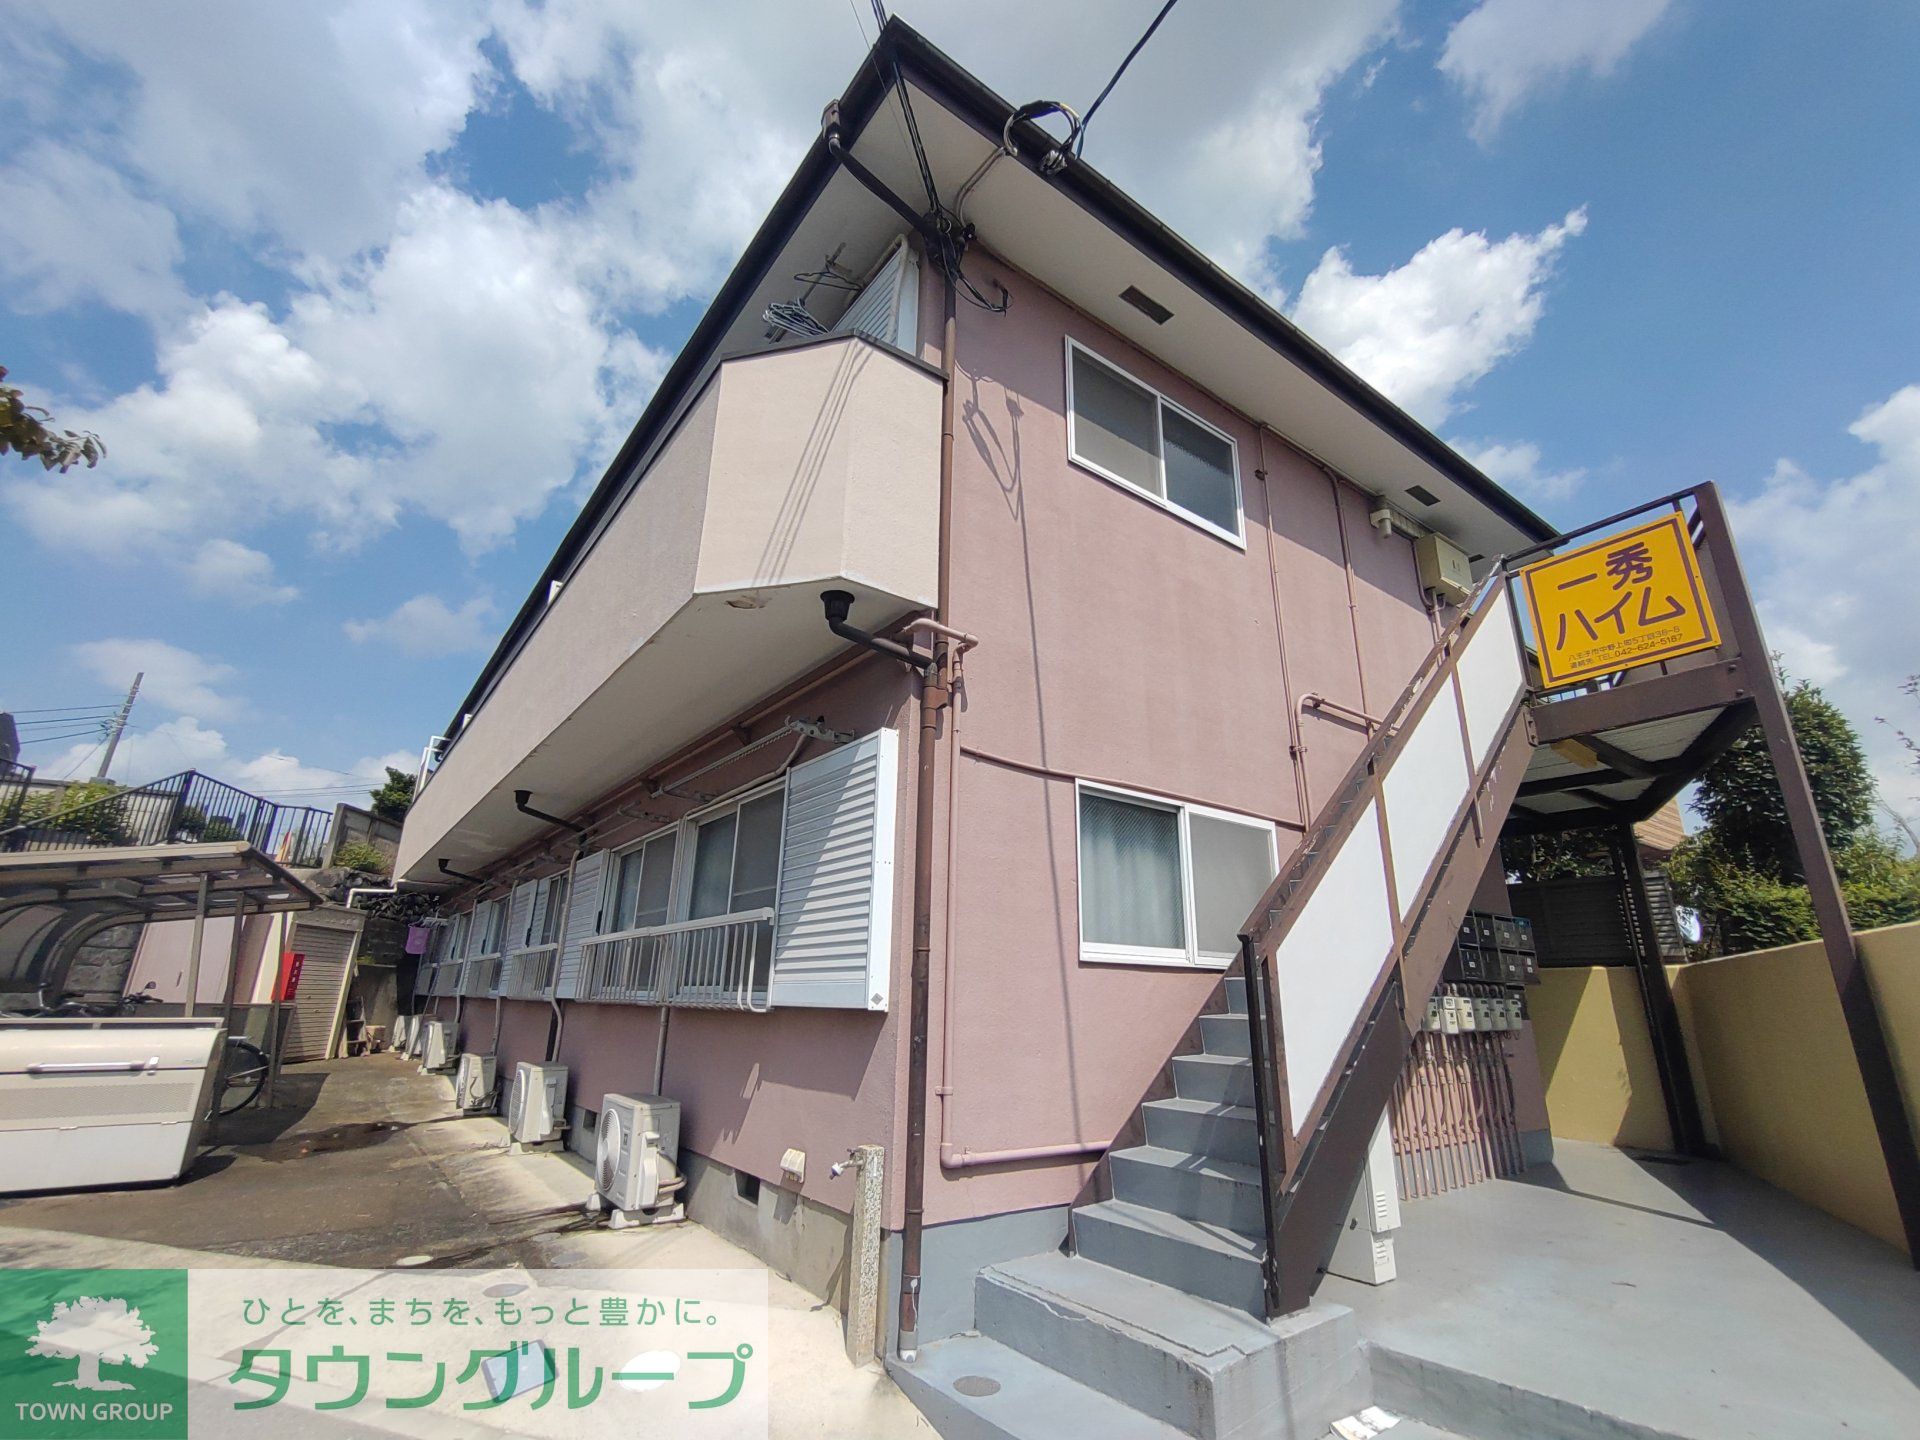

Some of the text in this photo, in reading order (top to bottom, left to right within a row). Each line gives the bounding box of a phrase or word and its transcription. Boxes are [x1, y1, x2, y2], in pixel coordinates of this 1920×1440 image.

[1557, 542, 1653, 591] 一秀
[1556, 587, 1687, 650] ハイム
